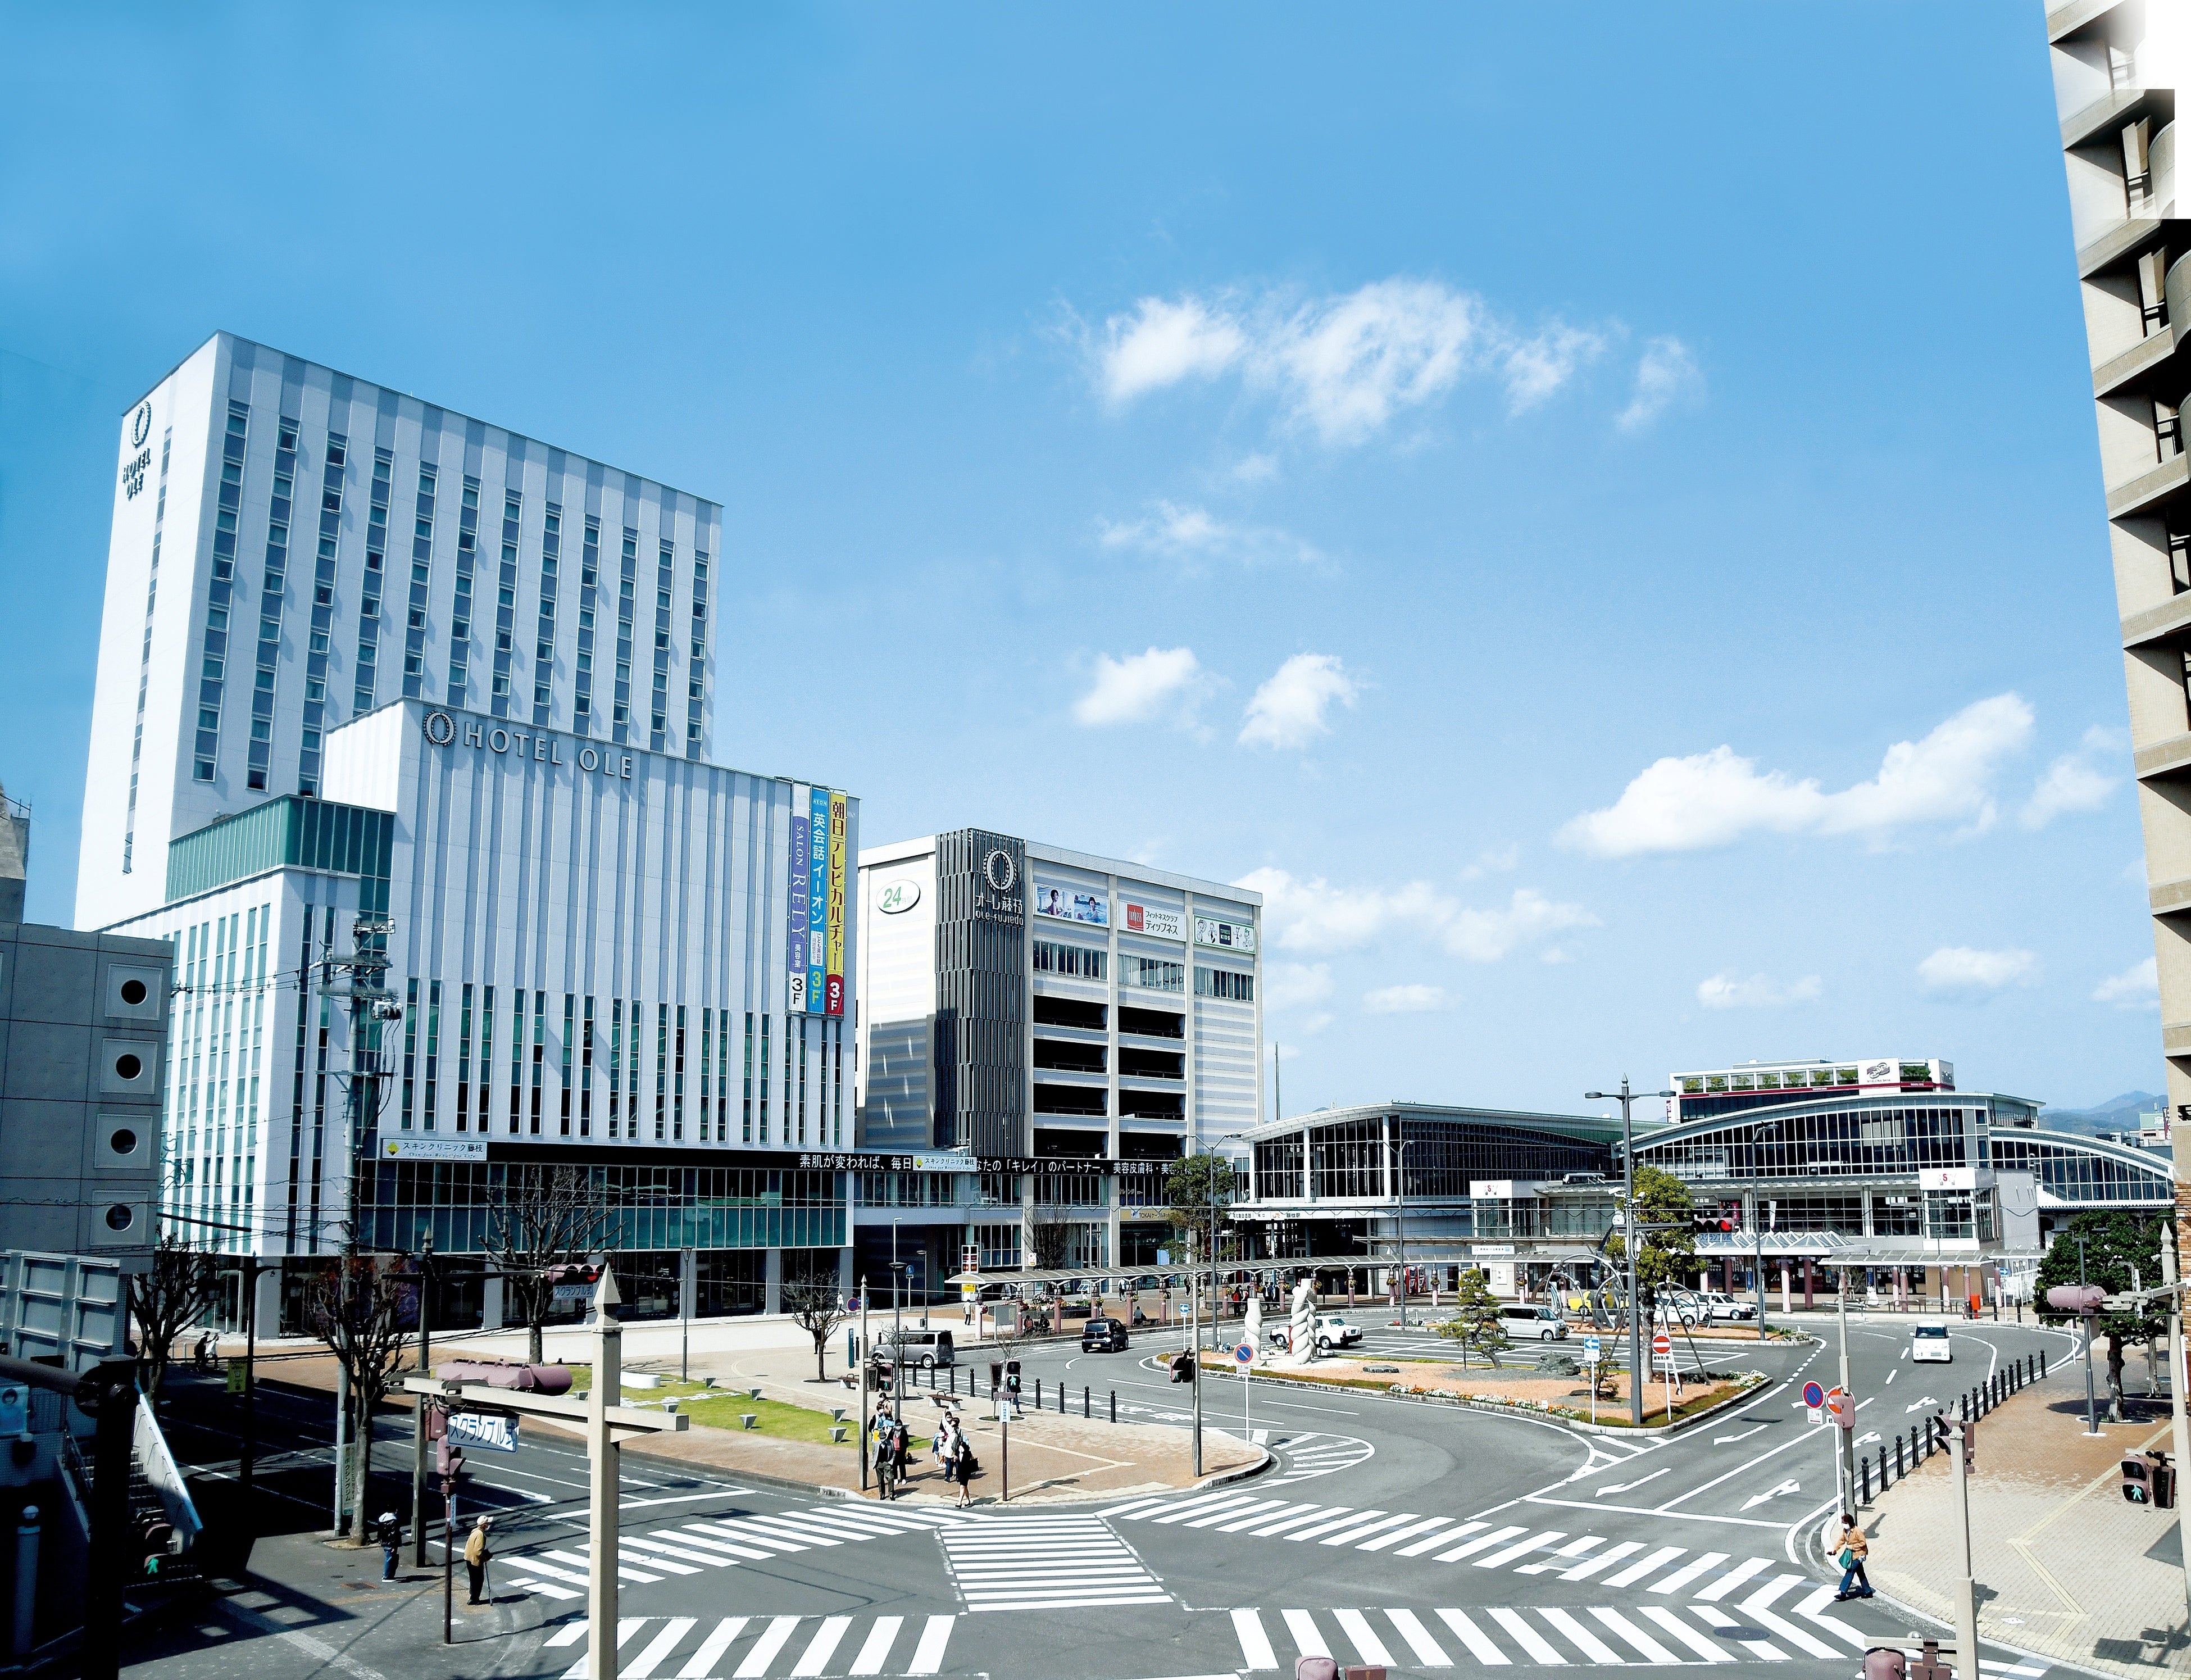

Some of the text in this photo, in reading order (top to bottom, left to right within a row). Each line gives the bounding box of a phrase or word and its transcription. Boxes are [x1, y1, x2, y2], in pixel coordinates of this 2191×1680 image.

[122, 448, 151, 484] HOTEL
[126, 473, 144, 501] OLE
[464, 721, 631, 779] HOTEL OLE
[792, 825, 806, 938] SALON RELY
[830, 801, 844, 970] 朝日テレビカルチャー
[975, 892, 1023, 915] オーレ藤枝
[1145, 911, 1178, 923] フィットネスクラブ
[1145, 920, 1178, 936] ティップネス
[555, 1285, 592, 1296] スクランブル式
[450, 1416, 516, 1447] スクランブル式
